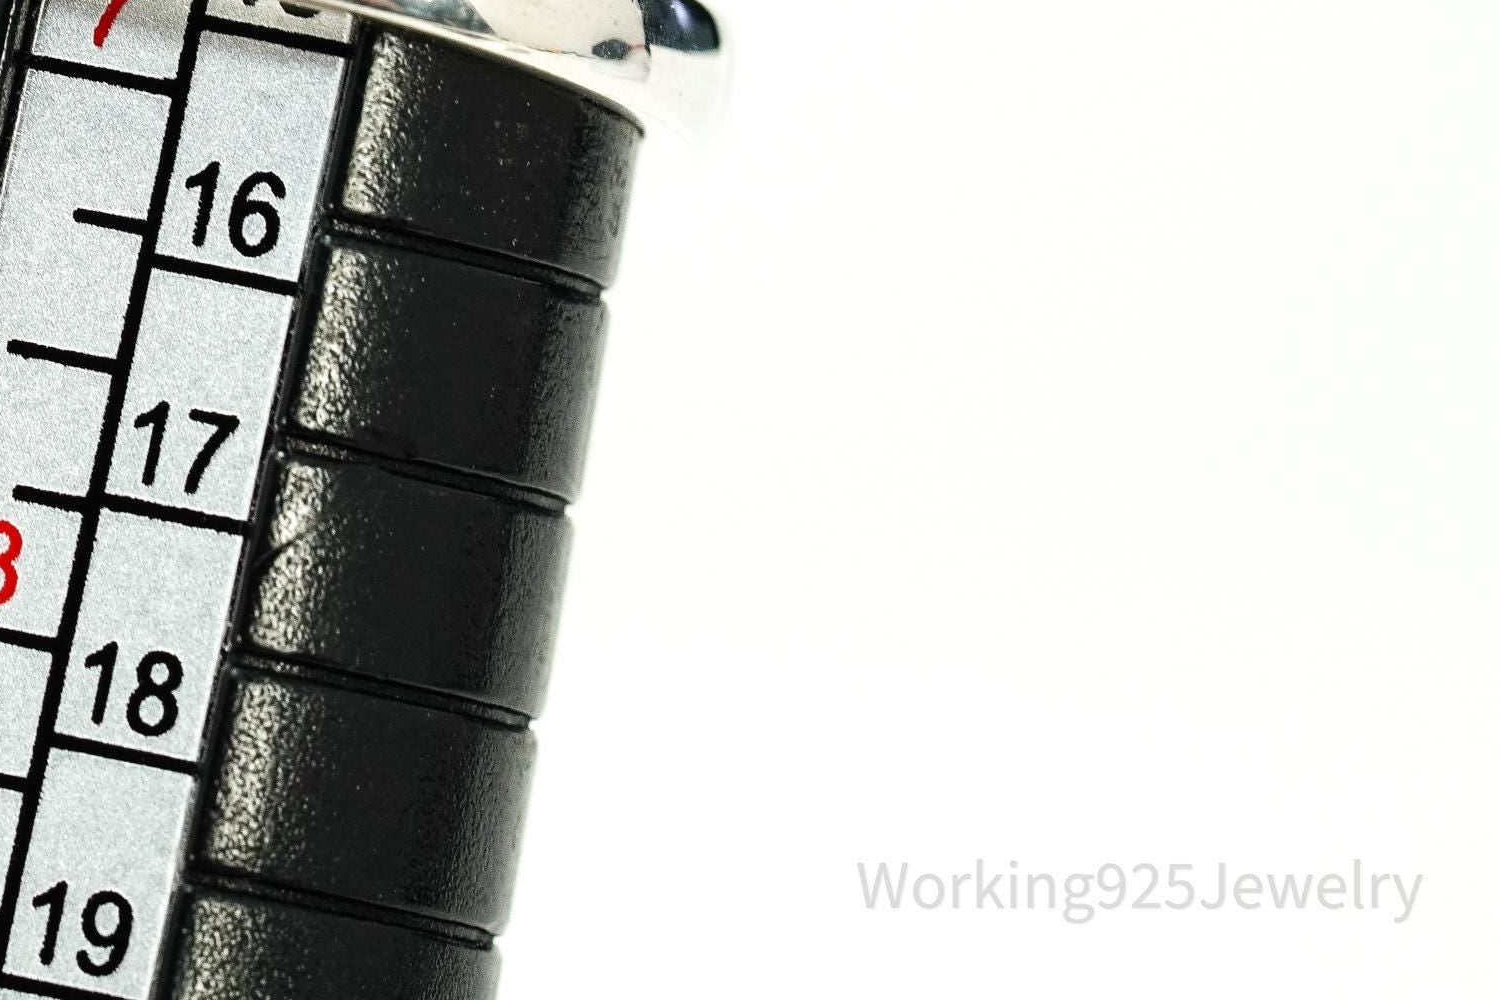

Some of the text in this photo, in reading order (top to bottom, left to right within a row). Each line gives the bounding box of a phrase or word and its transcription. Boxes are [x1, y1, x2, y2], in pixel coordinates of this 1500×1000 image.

[184, 160, 287, 258] 16
[133, 400, 241, 495] 17
[84, 641, 185, 738] 18
[32, 880, 134, 978] 19
